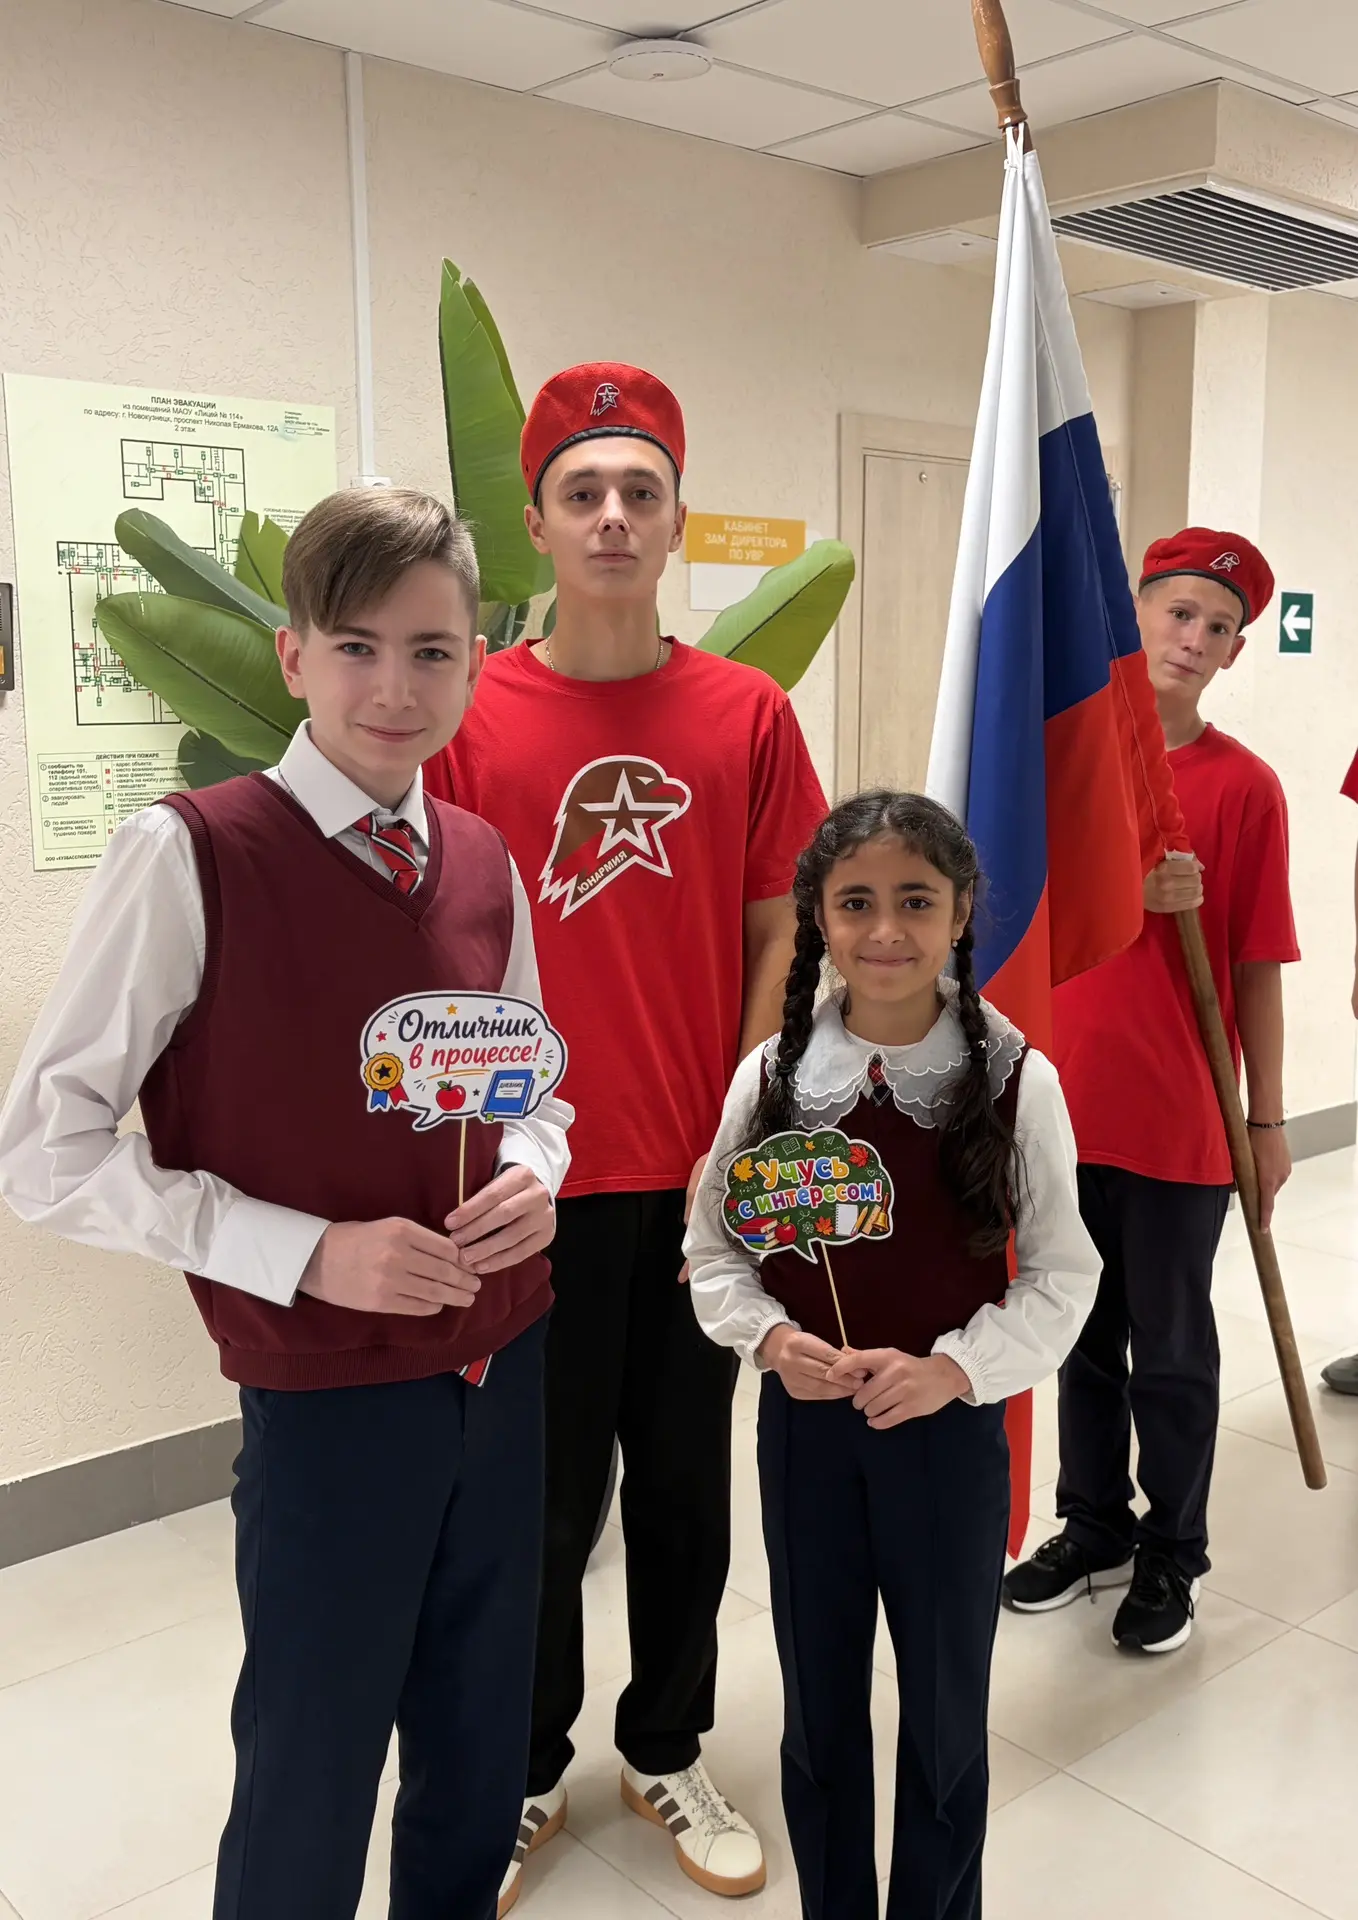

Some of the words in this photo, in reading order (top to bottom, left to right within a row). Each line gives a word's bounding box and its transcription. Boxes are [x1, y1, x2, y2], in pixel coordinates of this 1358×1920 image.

[151, 396, 171, 404] ПЛАН
[173, 399, 216, 409] ЭВАКУАЦИИ
[132, 404, 171, 413] помещений
[172, 407, 193, 415] МАОУ
[195, 409, 218, 418] «Лицей
[219, 411, 227, 419] №
[173, 417, 203, 425] проспект
[204, 419, 232, 427] Николая
[233, 421, 265, 431] Ермакова,
[174, 424, 179, 432] 2
[724, 520, 769, 533] КАБИНЕТ
[730, 535, 788, 549] ДИРЕКТОРА
[729, 549, 742, 560] ПО
[744, 550, 765, 561] УВР
[56, 853, 102, 861] «КУЗБАССПОЖСЕРВИ
[577, 850, 628, 894] ЮНАРМИЯ
[399, 1009, 538, 1043] Отличник
[409, 1043, 424, 1069] в
[431, 1037, 543, 1074] процессе!
[755, 1157, 849, 1189] Учусь
[755, 1179, 883, 1209] интересом!
